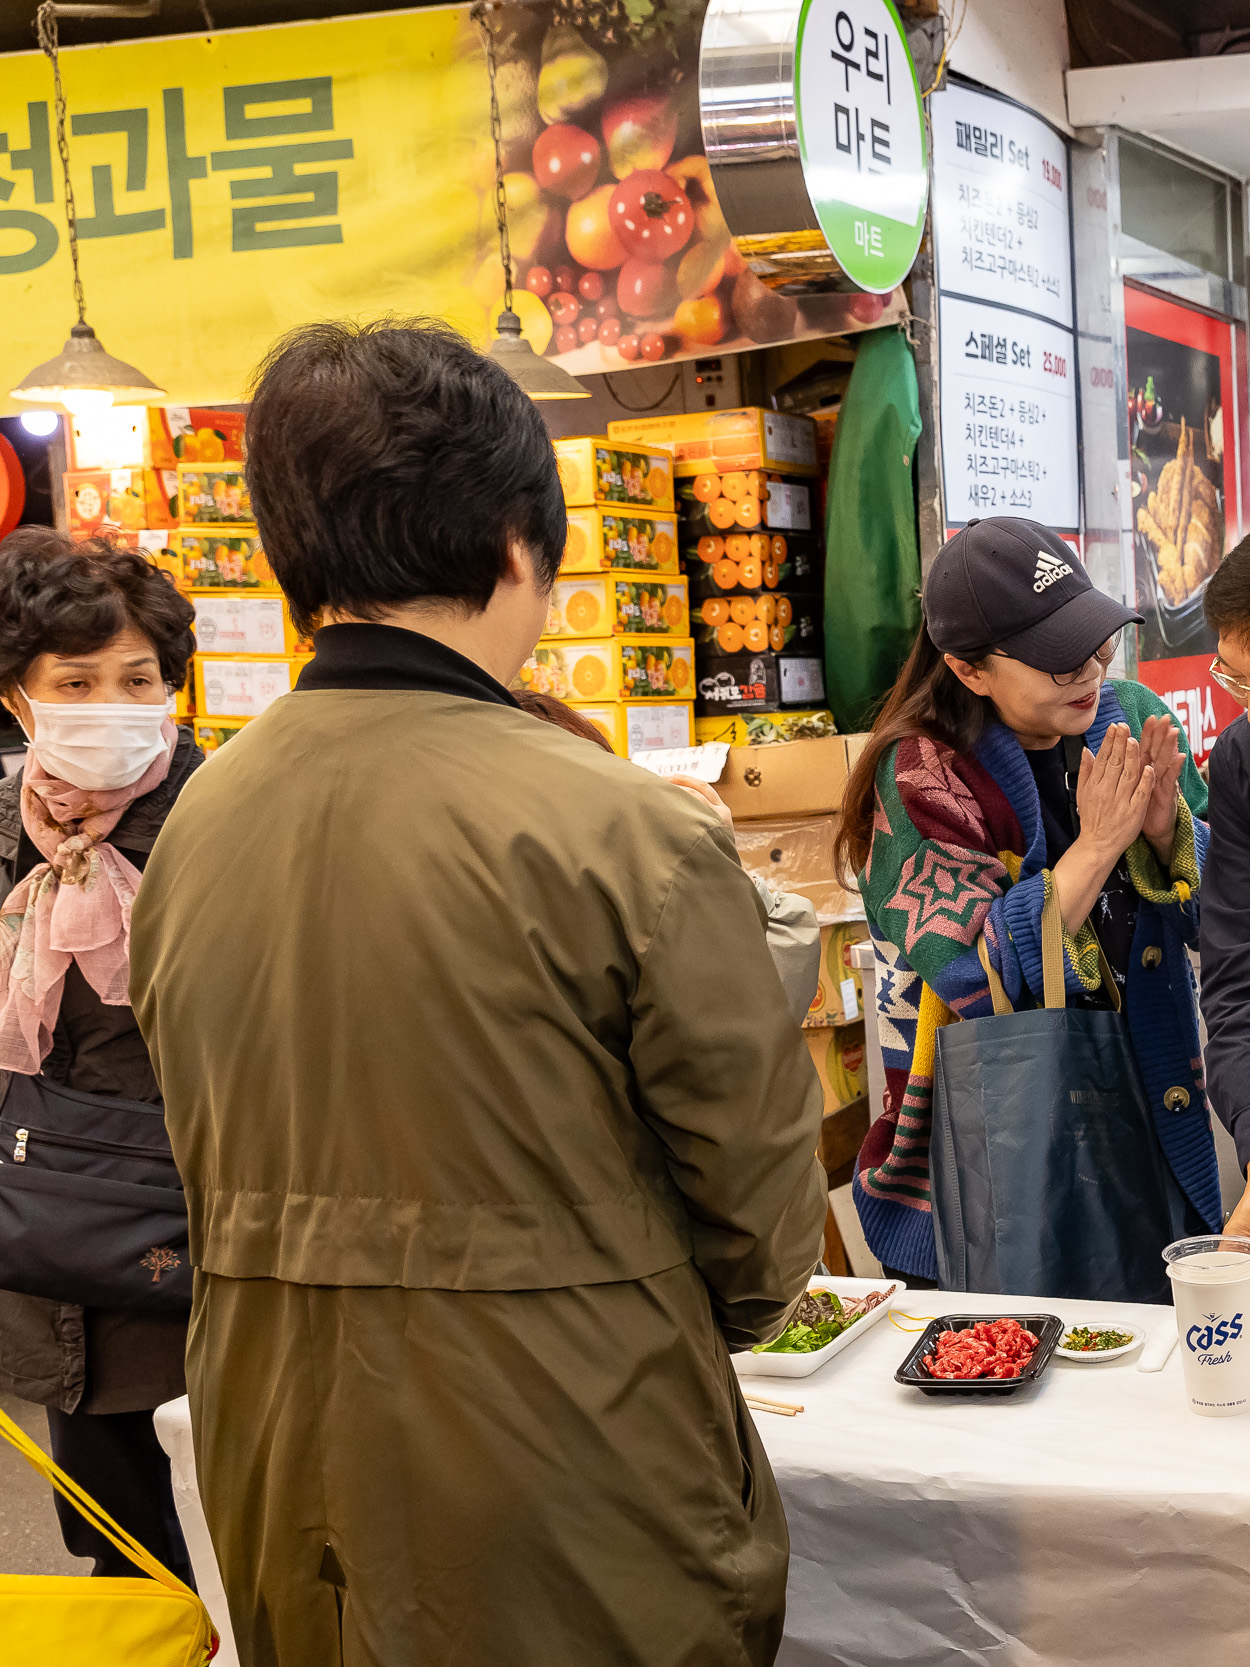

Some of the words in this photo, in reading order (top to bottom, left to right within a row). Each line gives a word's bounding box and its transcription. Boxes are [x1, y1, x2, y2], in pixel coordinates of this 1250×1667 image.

[831, 10, 891, 105] 우리
[834, 102, 891, 175] 마트
[955, 121, 1004, 163] 패밀리
[1008, 140, 1030, 170] Set
[854, 220, 885, 257] 마트
[965, 331, 1008, 365] 스페셜
[1011, 342, 1031, 368] Set
[1043, 351, 1067, 378] 25,000
[965, 392, 1005, 419] 치즈돈2
[1018, 401, 1040, 425] 등심2
[965, 423, 1016, 449] 치킨텐더4
[967, 454, 1040, 480] 치즈고구마스틱2
[968, 484, 997, 508] 새우2
[1010, 490, 1032, 508] 소스3
[1033, 564, 1073, 593] adidas
[1197, 1351, 1233, 1366] Fresh
